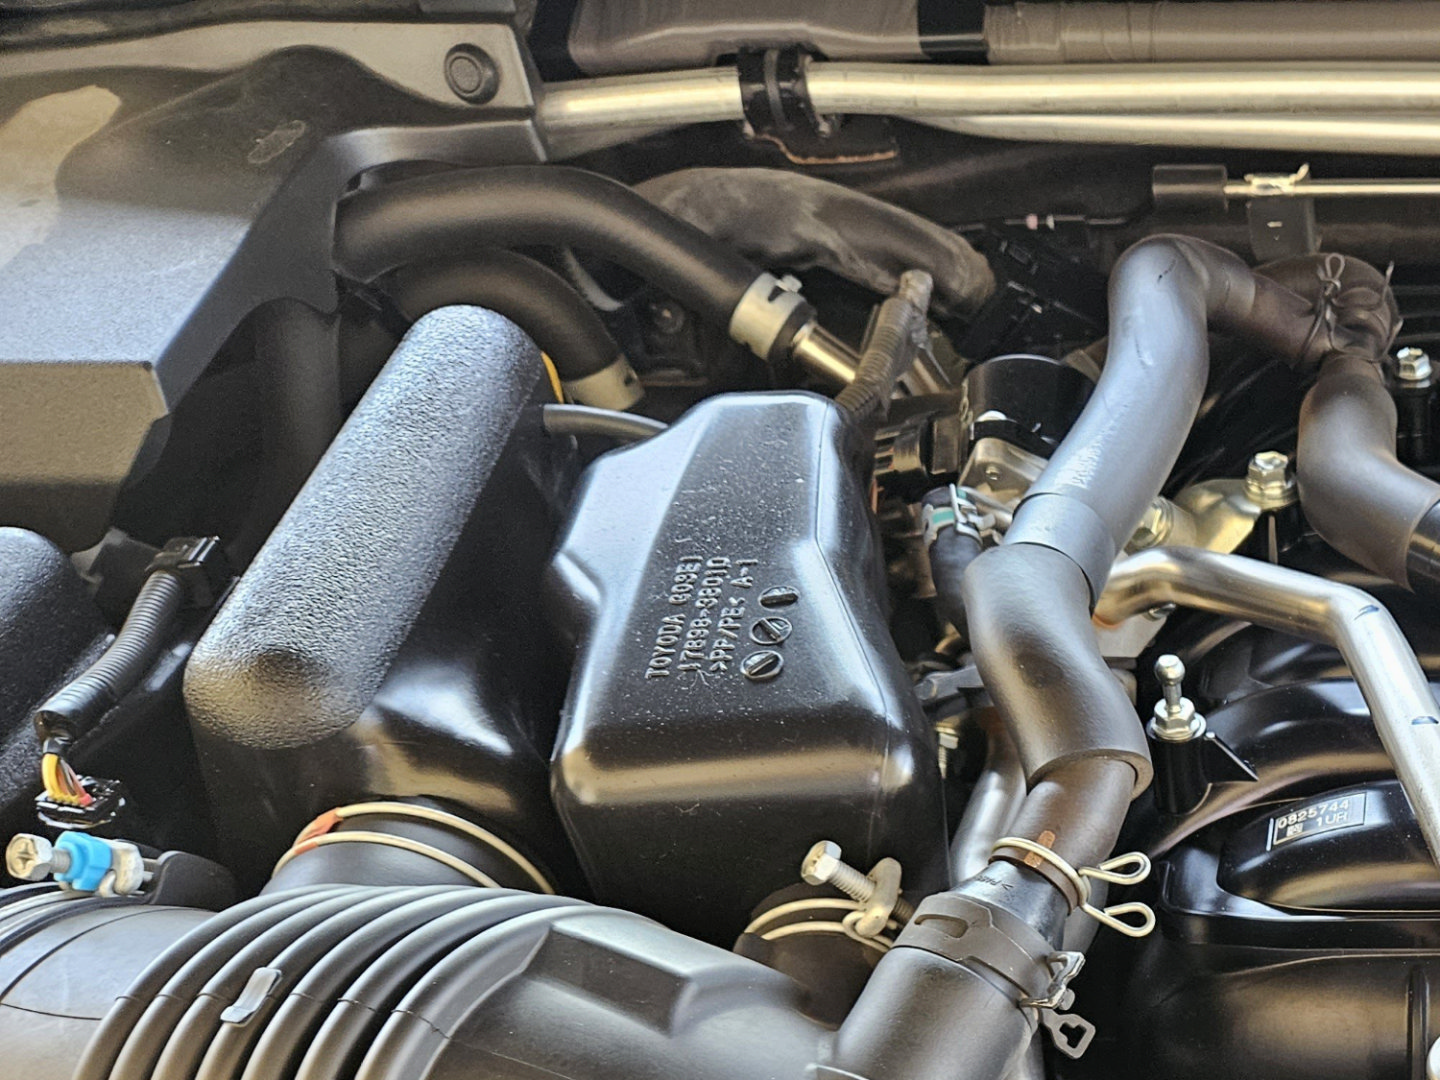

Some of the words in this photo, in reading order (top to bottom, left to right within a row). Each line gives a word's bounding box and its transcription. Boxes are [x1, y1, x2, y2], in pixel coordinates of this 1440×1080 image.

[730, 558, 758, 588] A-1
[644, 613, 686, 679] TOYODA
[668, 555, 703, 606] GOSEI
[1278, 800, 1349, 829] 0825744
